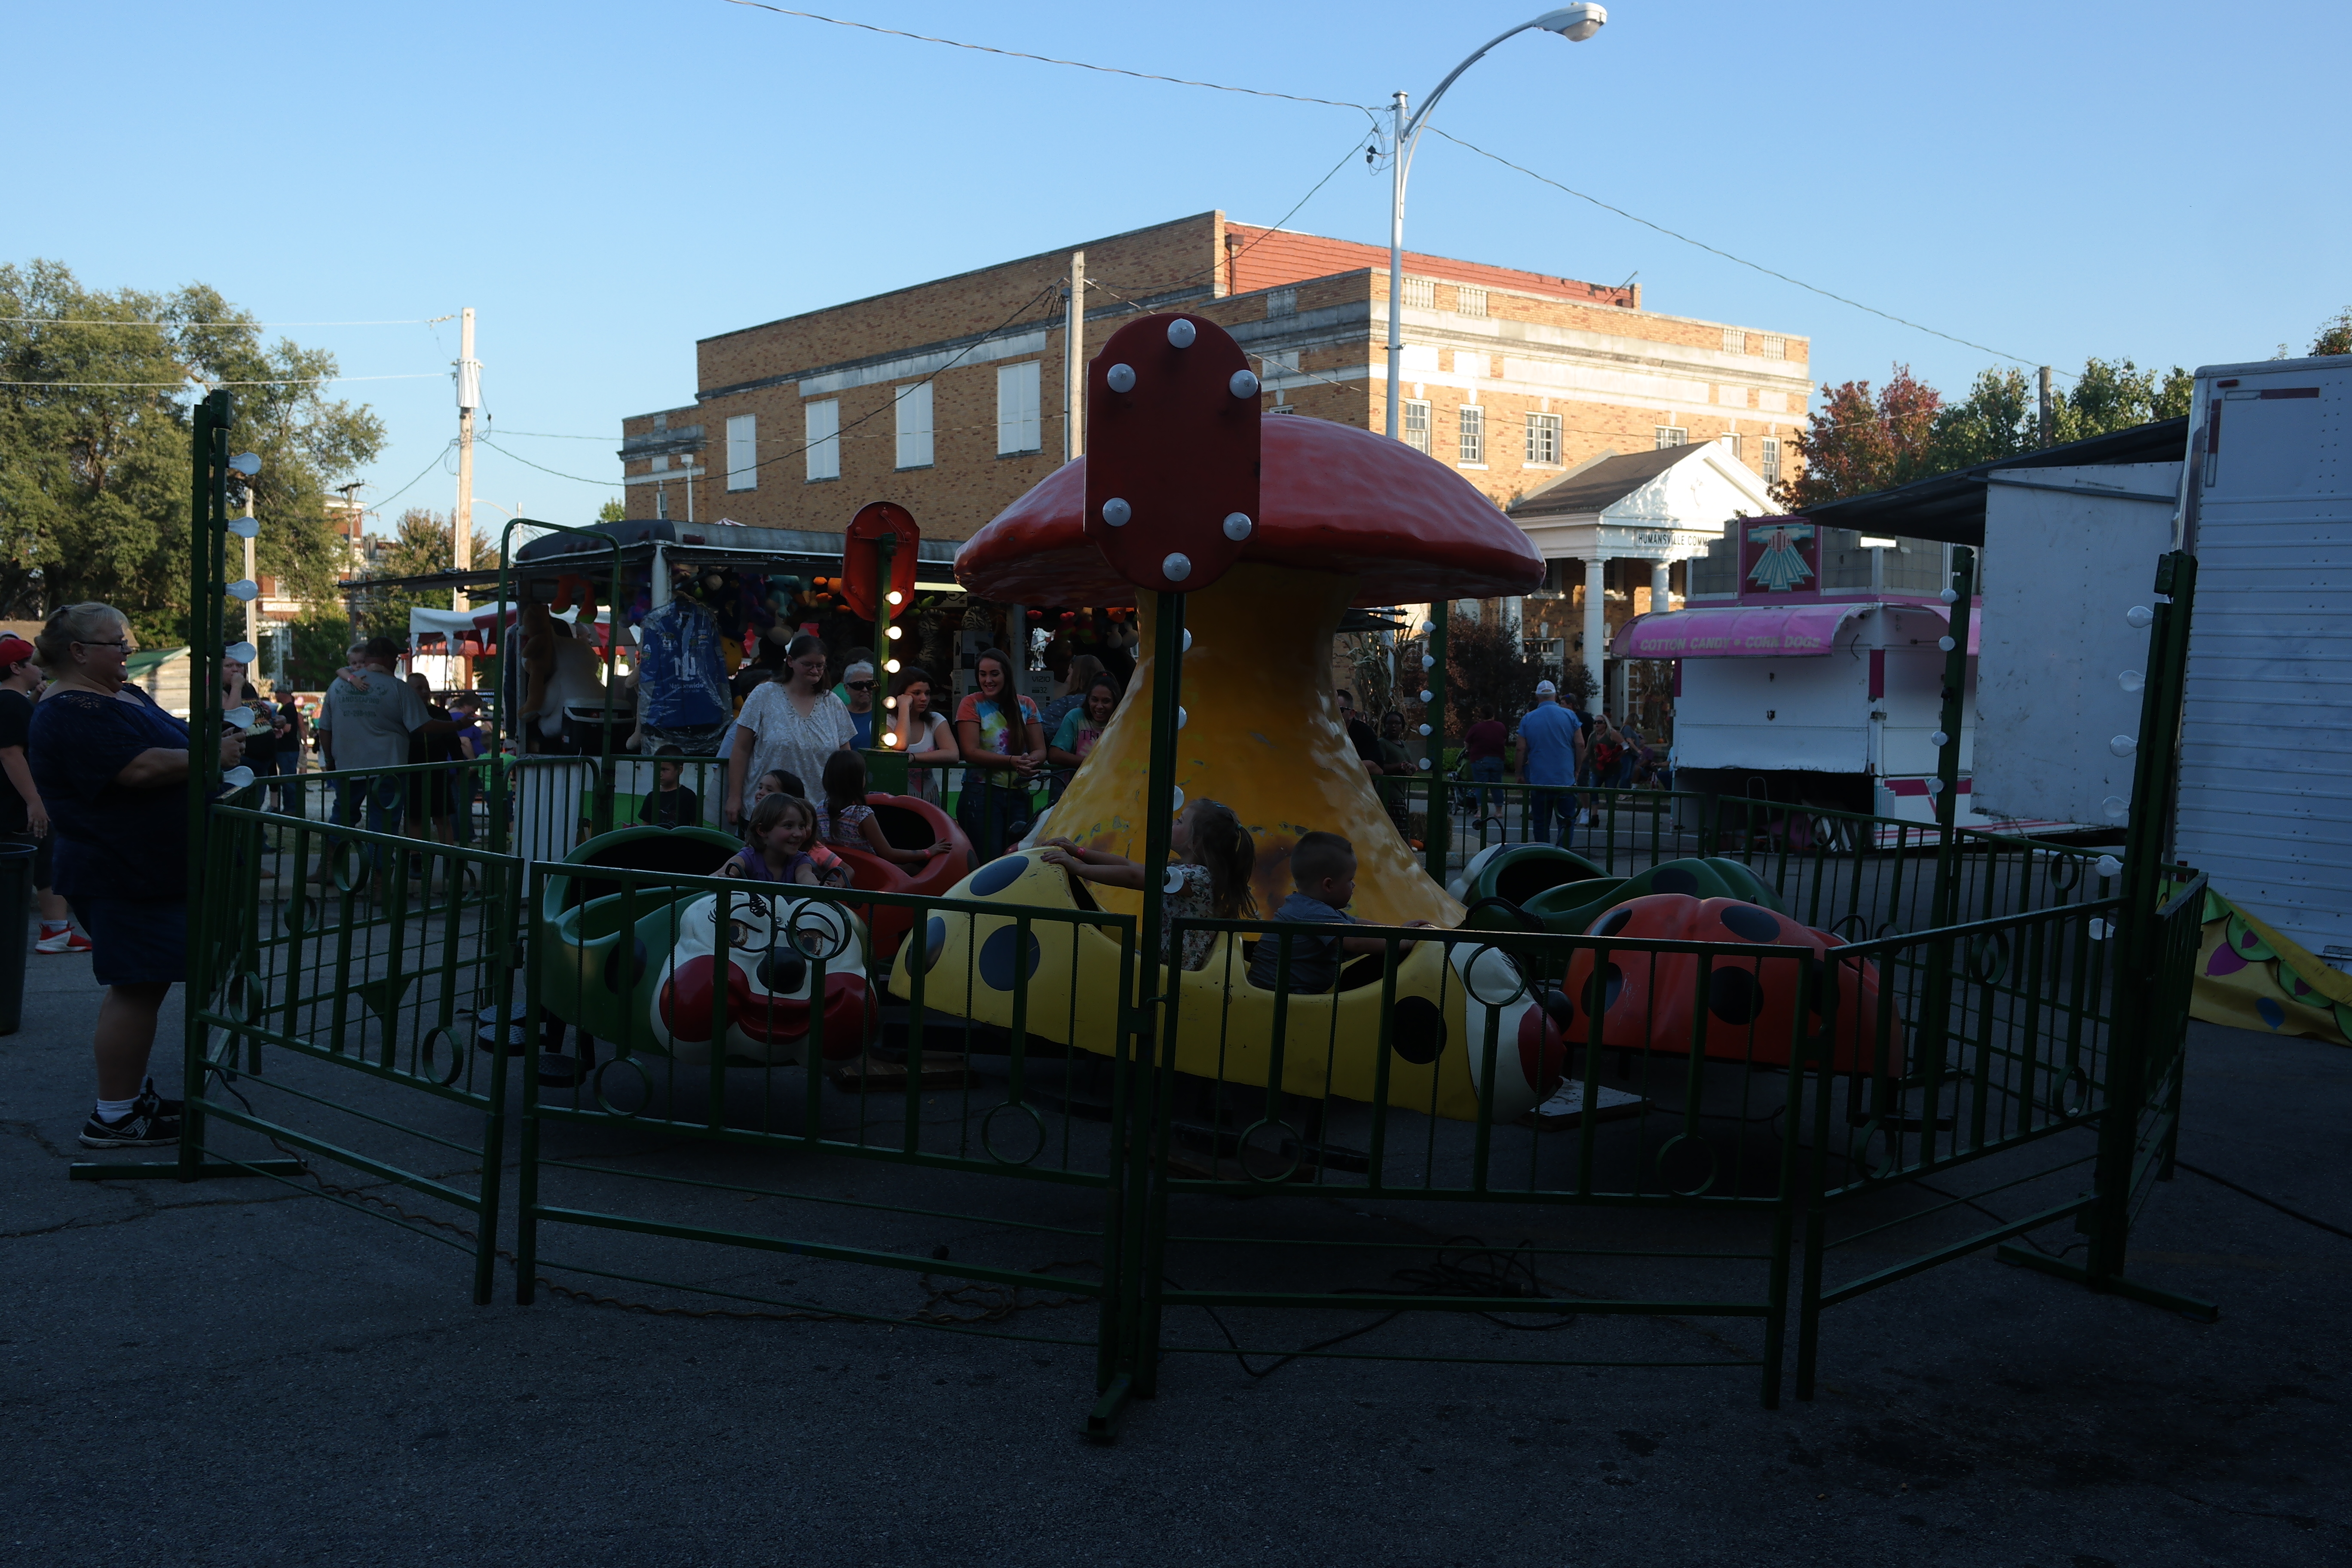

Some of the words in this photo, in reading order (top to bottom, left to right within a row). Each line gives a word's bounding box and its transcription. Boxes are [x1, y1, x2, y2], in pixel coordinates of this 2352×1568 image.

[1638, 533, 1684, 545] HUMANSVILLE
[1640, 638, 1687, 651] COTTON
[1690, 637, 1731, 649] CANDY
[1746, 636, 1781, 649] CORN
[1784, 635, 1821, 648] DOGS
[338, 695, 380, 704] LANDSCAPING
